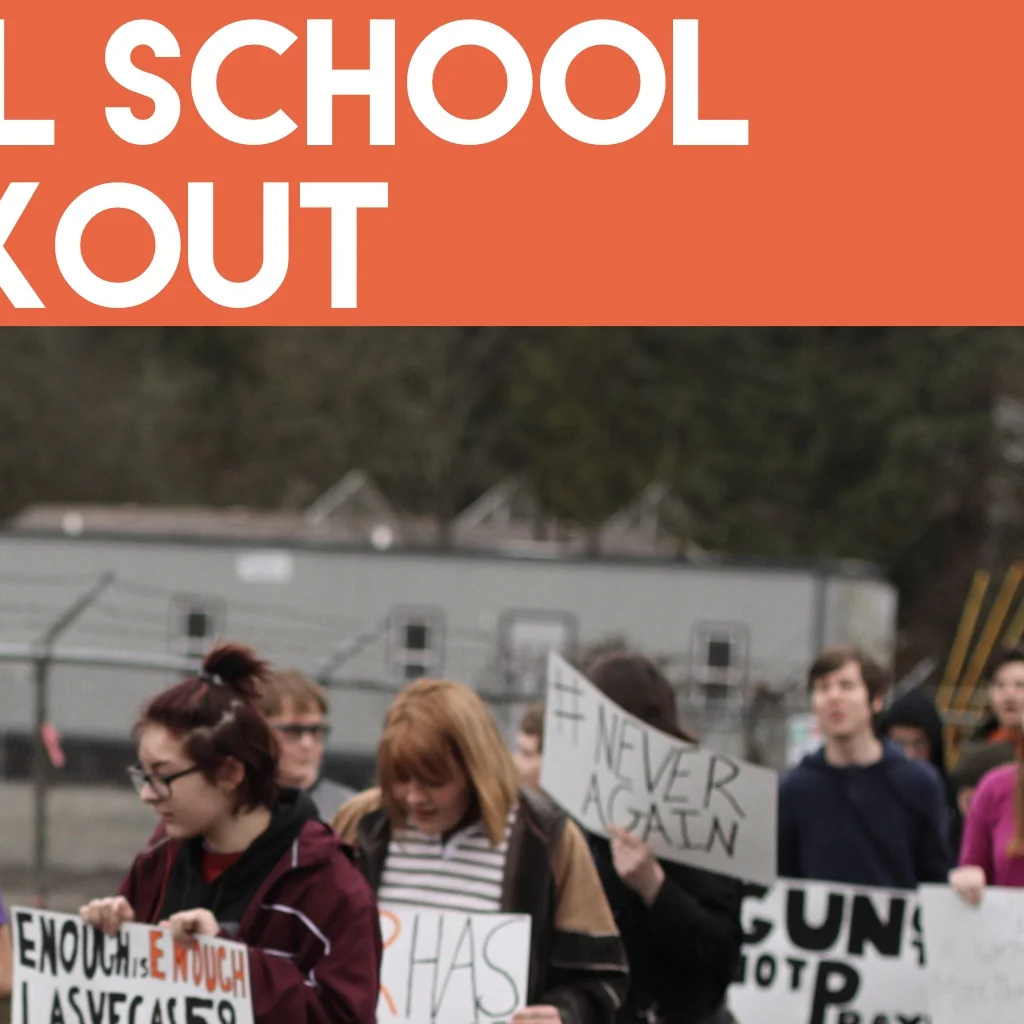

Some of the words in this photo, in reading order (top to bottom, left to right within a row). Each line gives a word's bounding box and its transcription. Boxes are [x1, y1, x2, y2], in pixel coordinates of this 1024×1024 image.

[580, 773, 739, 858] AGAIN
[16, 911, 131, 979] ENOUGH
[149, 930, 248, 998] ENOUGH
